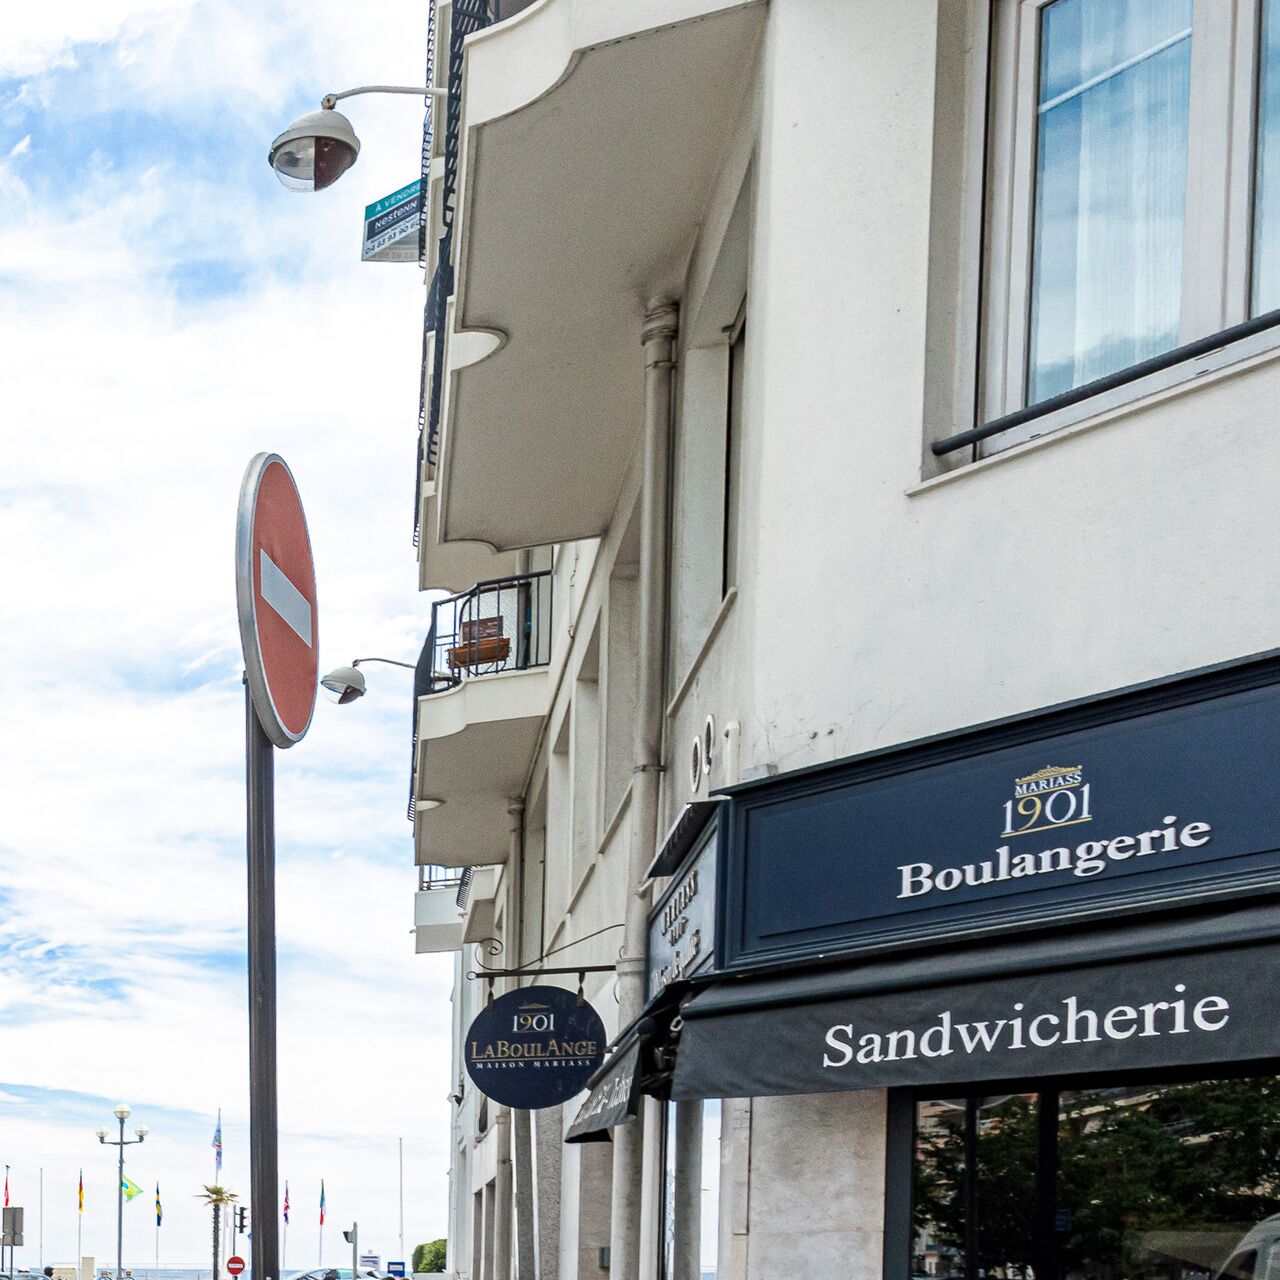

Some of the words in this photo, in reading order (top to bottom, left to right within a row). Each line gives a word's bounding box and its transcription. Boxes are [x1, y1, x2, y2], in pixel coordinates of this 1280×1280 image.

[1014, 771, 1082, 796] MARIASS
[1002, 783, 1093, 834] 1901
[896, 815, 1213, 899] Boulangerie
[512, 1013, 555, 1032] 1901
[821, 983, 1230, 1069] Sandwicherie
[476, 1061, 525, 1069] MAISON
[533, 1060, 591, 1068] MARIASS
